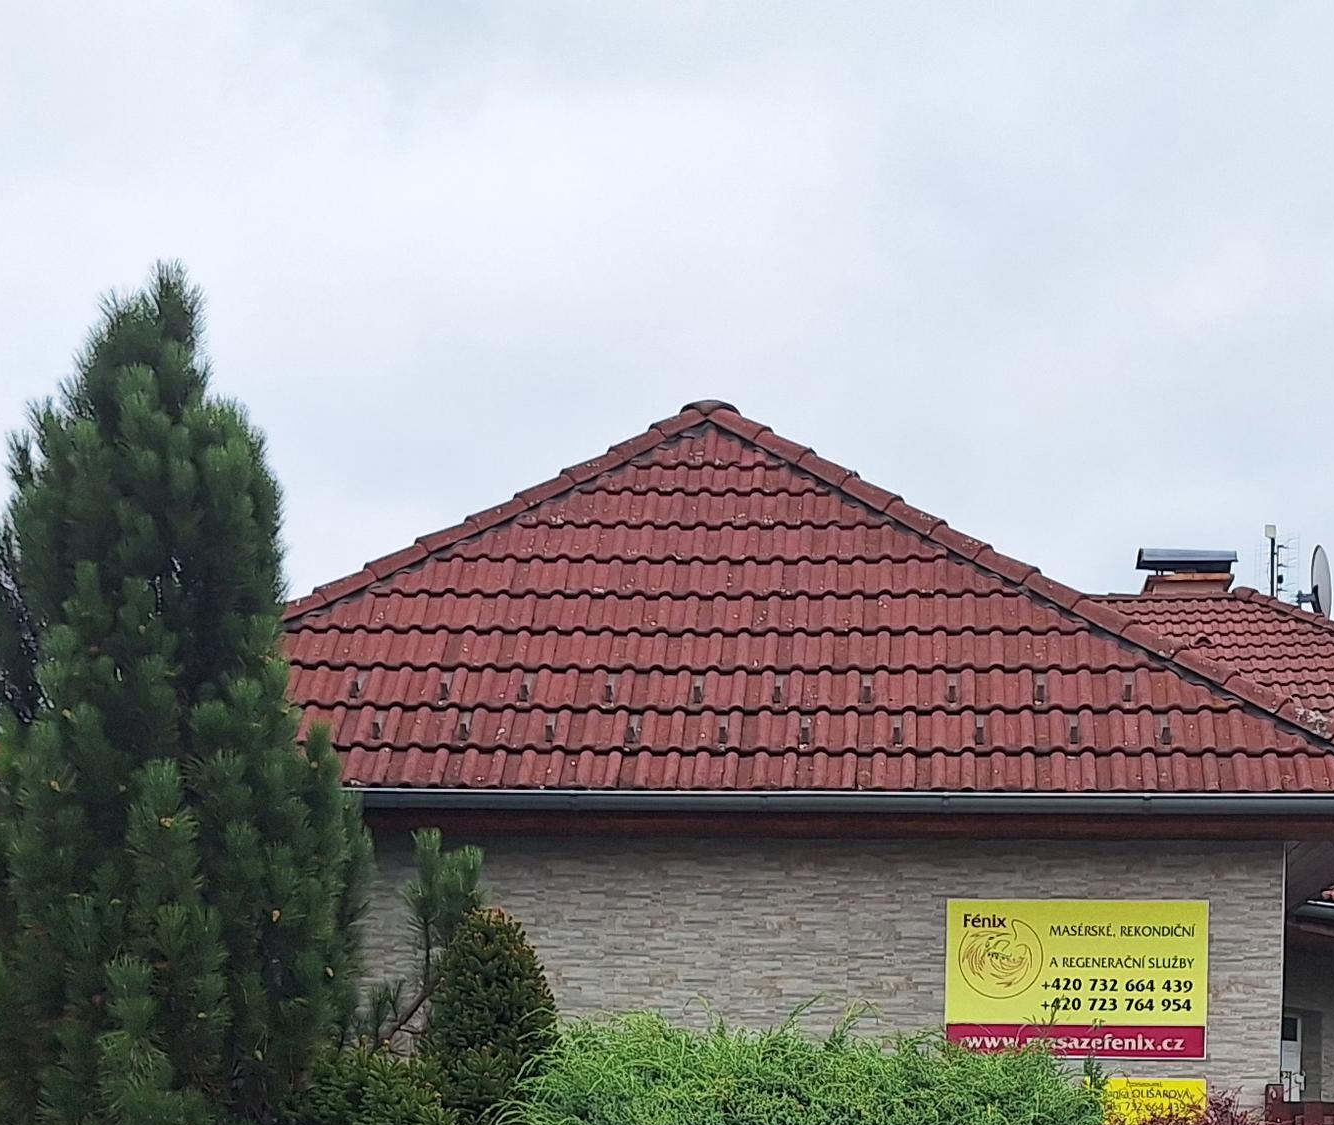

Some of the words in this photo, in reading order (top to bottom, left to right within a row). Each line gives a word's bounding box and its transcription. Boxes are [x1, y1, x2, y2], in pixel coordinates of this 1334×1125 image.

[963, 913, 1007, 928] Fénix
[1049, 922, 1116, 938] MASÉRSKÉ,
[1120, 923, 1196, 938] REKONDIČNÍ
[1049, 956, 1058, 968] A
[1062, 954, 1147, 969] REGENERAČNÍ
[1148, 955, 1195, 969] SLUŽBY
[1041, 978, 1082, 991] +420
[1089, 978, 1118, 992] 732
[1125, 979, 1155, 992] 664
[1162, 979, 1193, 993] 439
[1041, 998, 1081, 1011] +420
[1088, 998, 1118, 1011] 723
[1125, 998, 1155, 1011] 764
[1161, 999, 1192, 1011] 954
